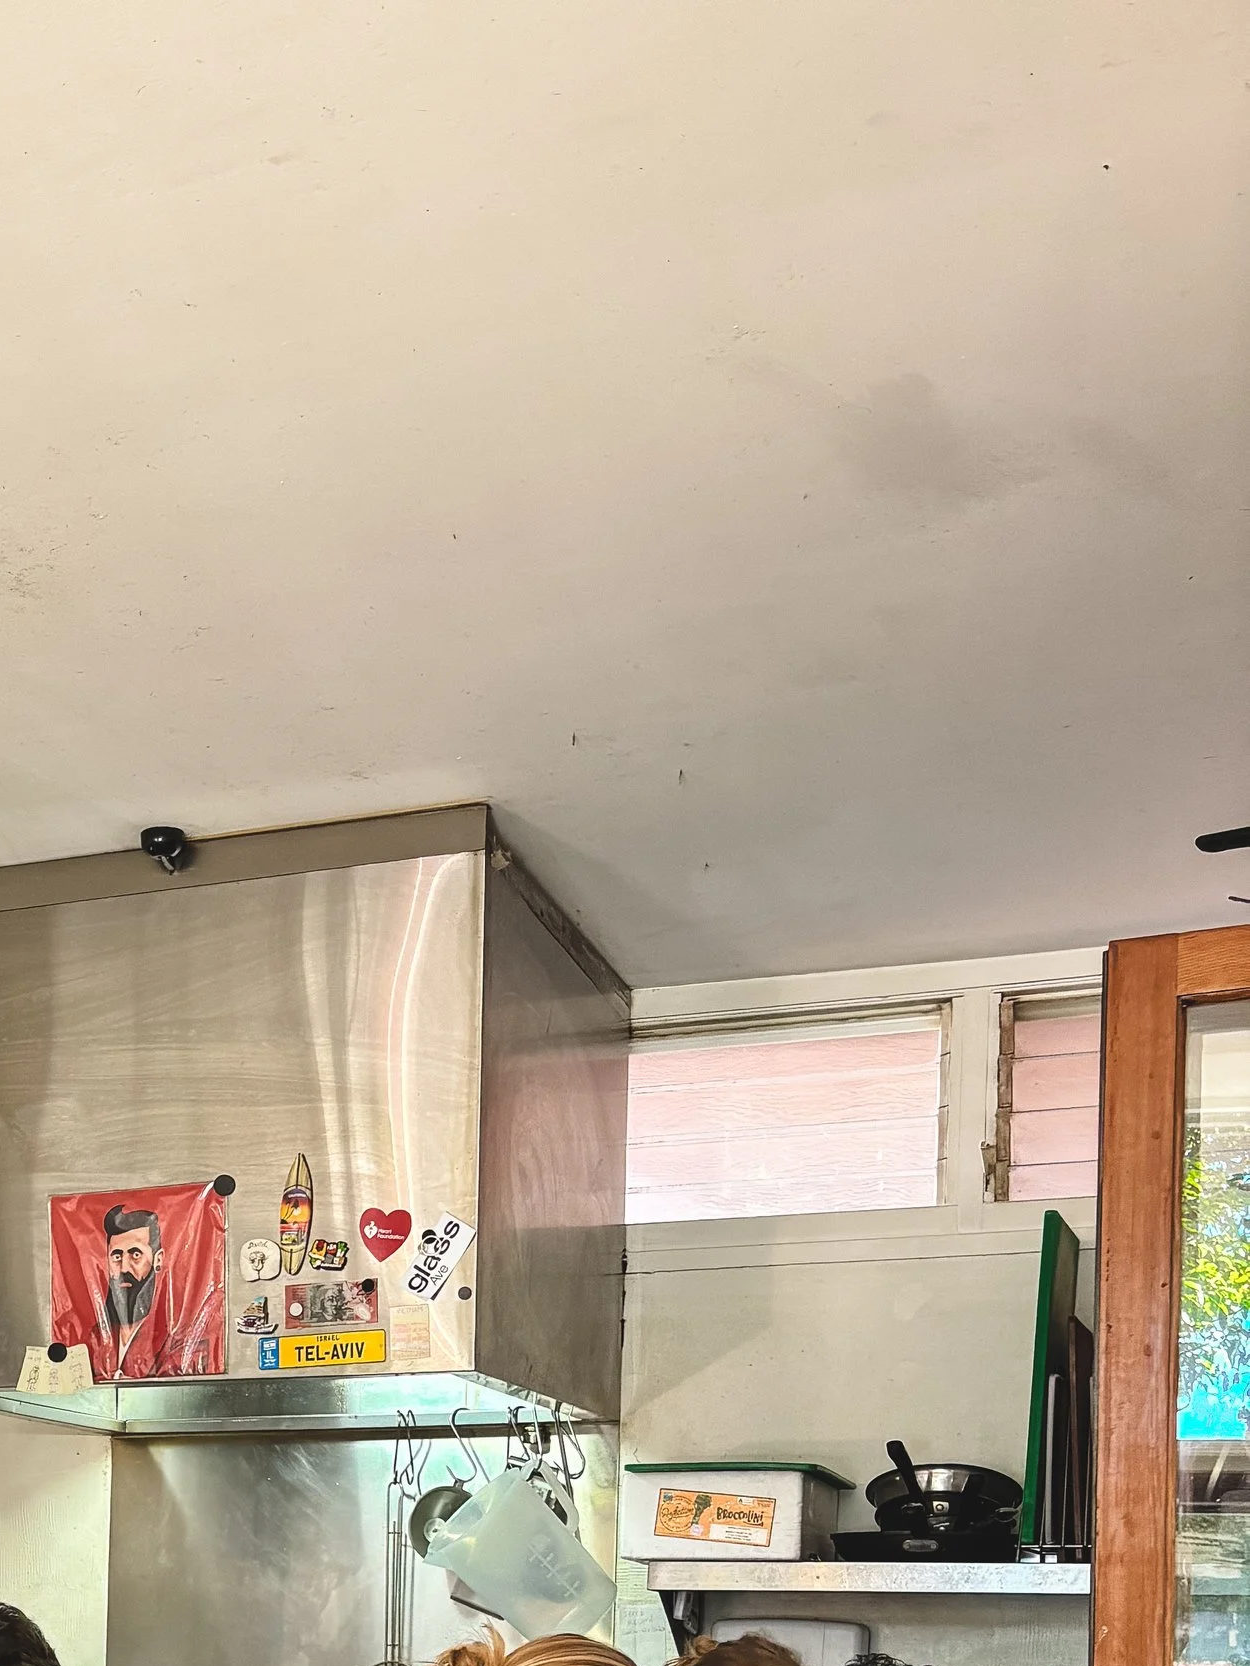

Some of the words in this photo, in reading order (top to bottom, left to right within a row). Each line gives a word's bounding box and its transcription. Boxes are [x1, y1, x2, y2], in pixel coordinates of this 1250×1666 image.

[429, 1264, 449, 1286] Ave
[316, 1334, 341, 1342] ISRAEL
[294, 1342, 365, 1363] TEL-AVIV
[716, 1507, 764, 1523] BROCCOLINI
